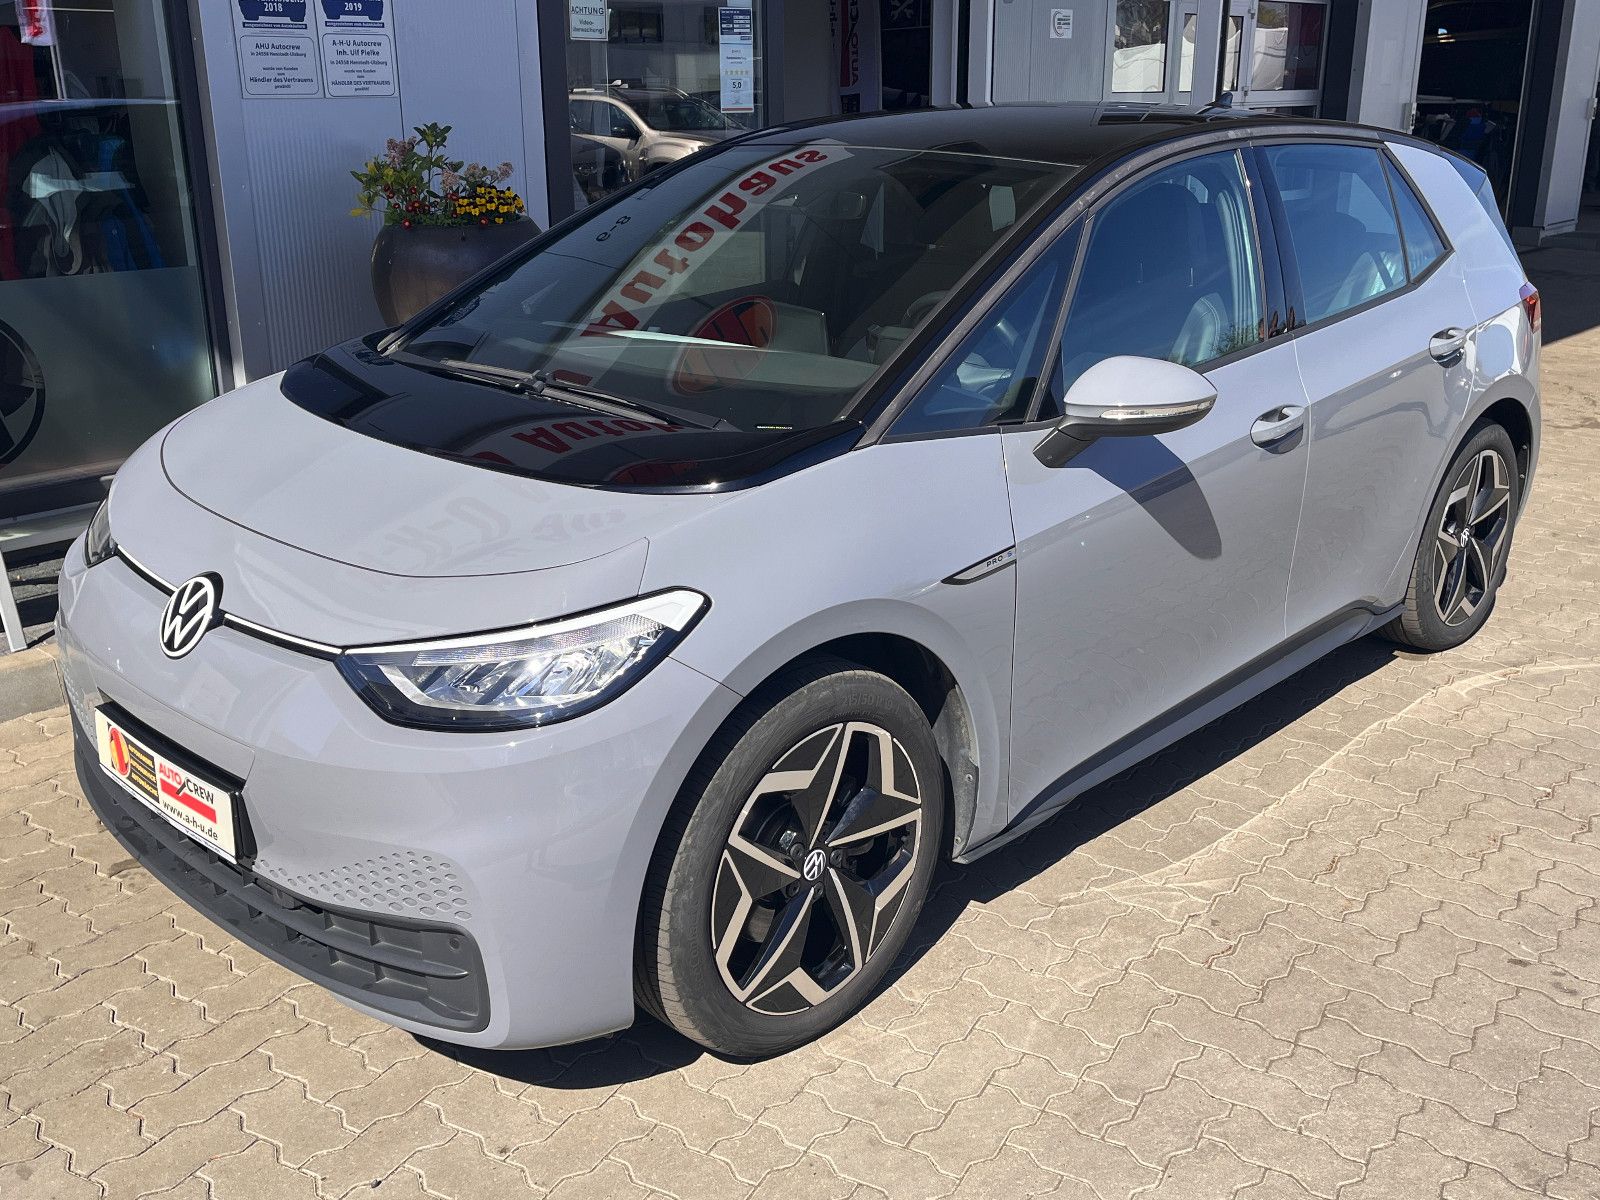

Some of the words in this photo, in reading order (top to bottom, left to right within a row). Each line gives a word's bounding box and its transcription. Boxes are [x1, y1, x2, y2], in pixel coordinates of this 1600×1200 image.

[263, 2, 283, 12] 2018
[344, 2, 362, 11] 2019
[571, 5, 604, 15] ACHTUNG
[255, 42, 270, 50] AHU
[986, 555, 1004, 568] PRO
[159, 762, 183, 786] AUTO
[186, 778, 214, 805] CREW
[162, 798, 219, 841] www.a-h-u.de
